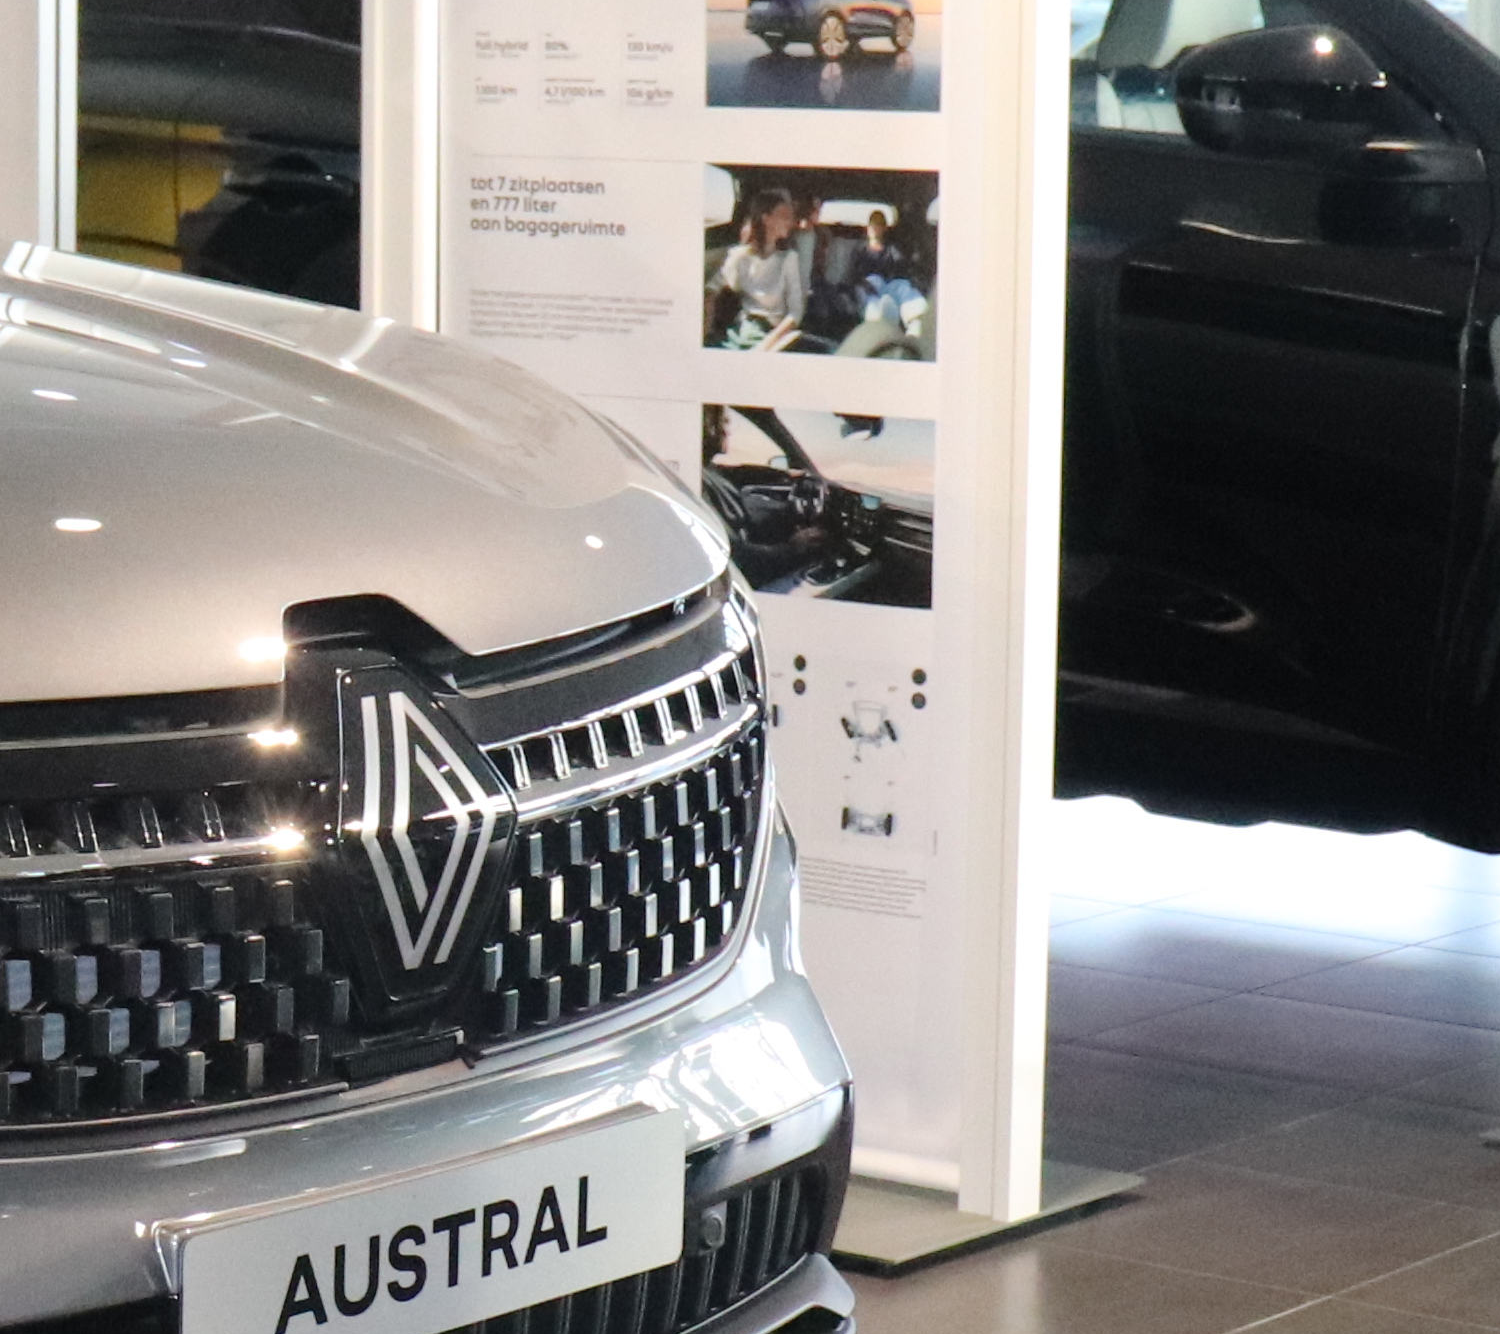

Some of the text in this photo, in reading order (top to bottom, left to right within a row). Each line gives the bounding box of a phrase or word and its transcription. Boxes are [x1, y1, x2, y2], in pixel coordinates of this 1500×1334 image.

[471, 176, 605, 195] tot 7 zitplaatsen
[470, 196, 557, 213] en 777 liter
[470, 216, 626, 238] aan bagageruimte
